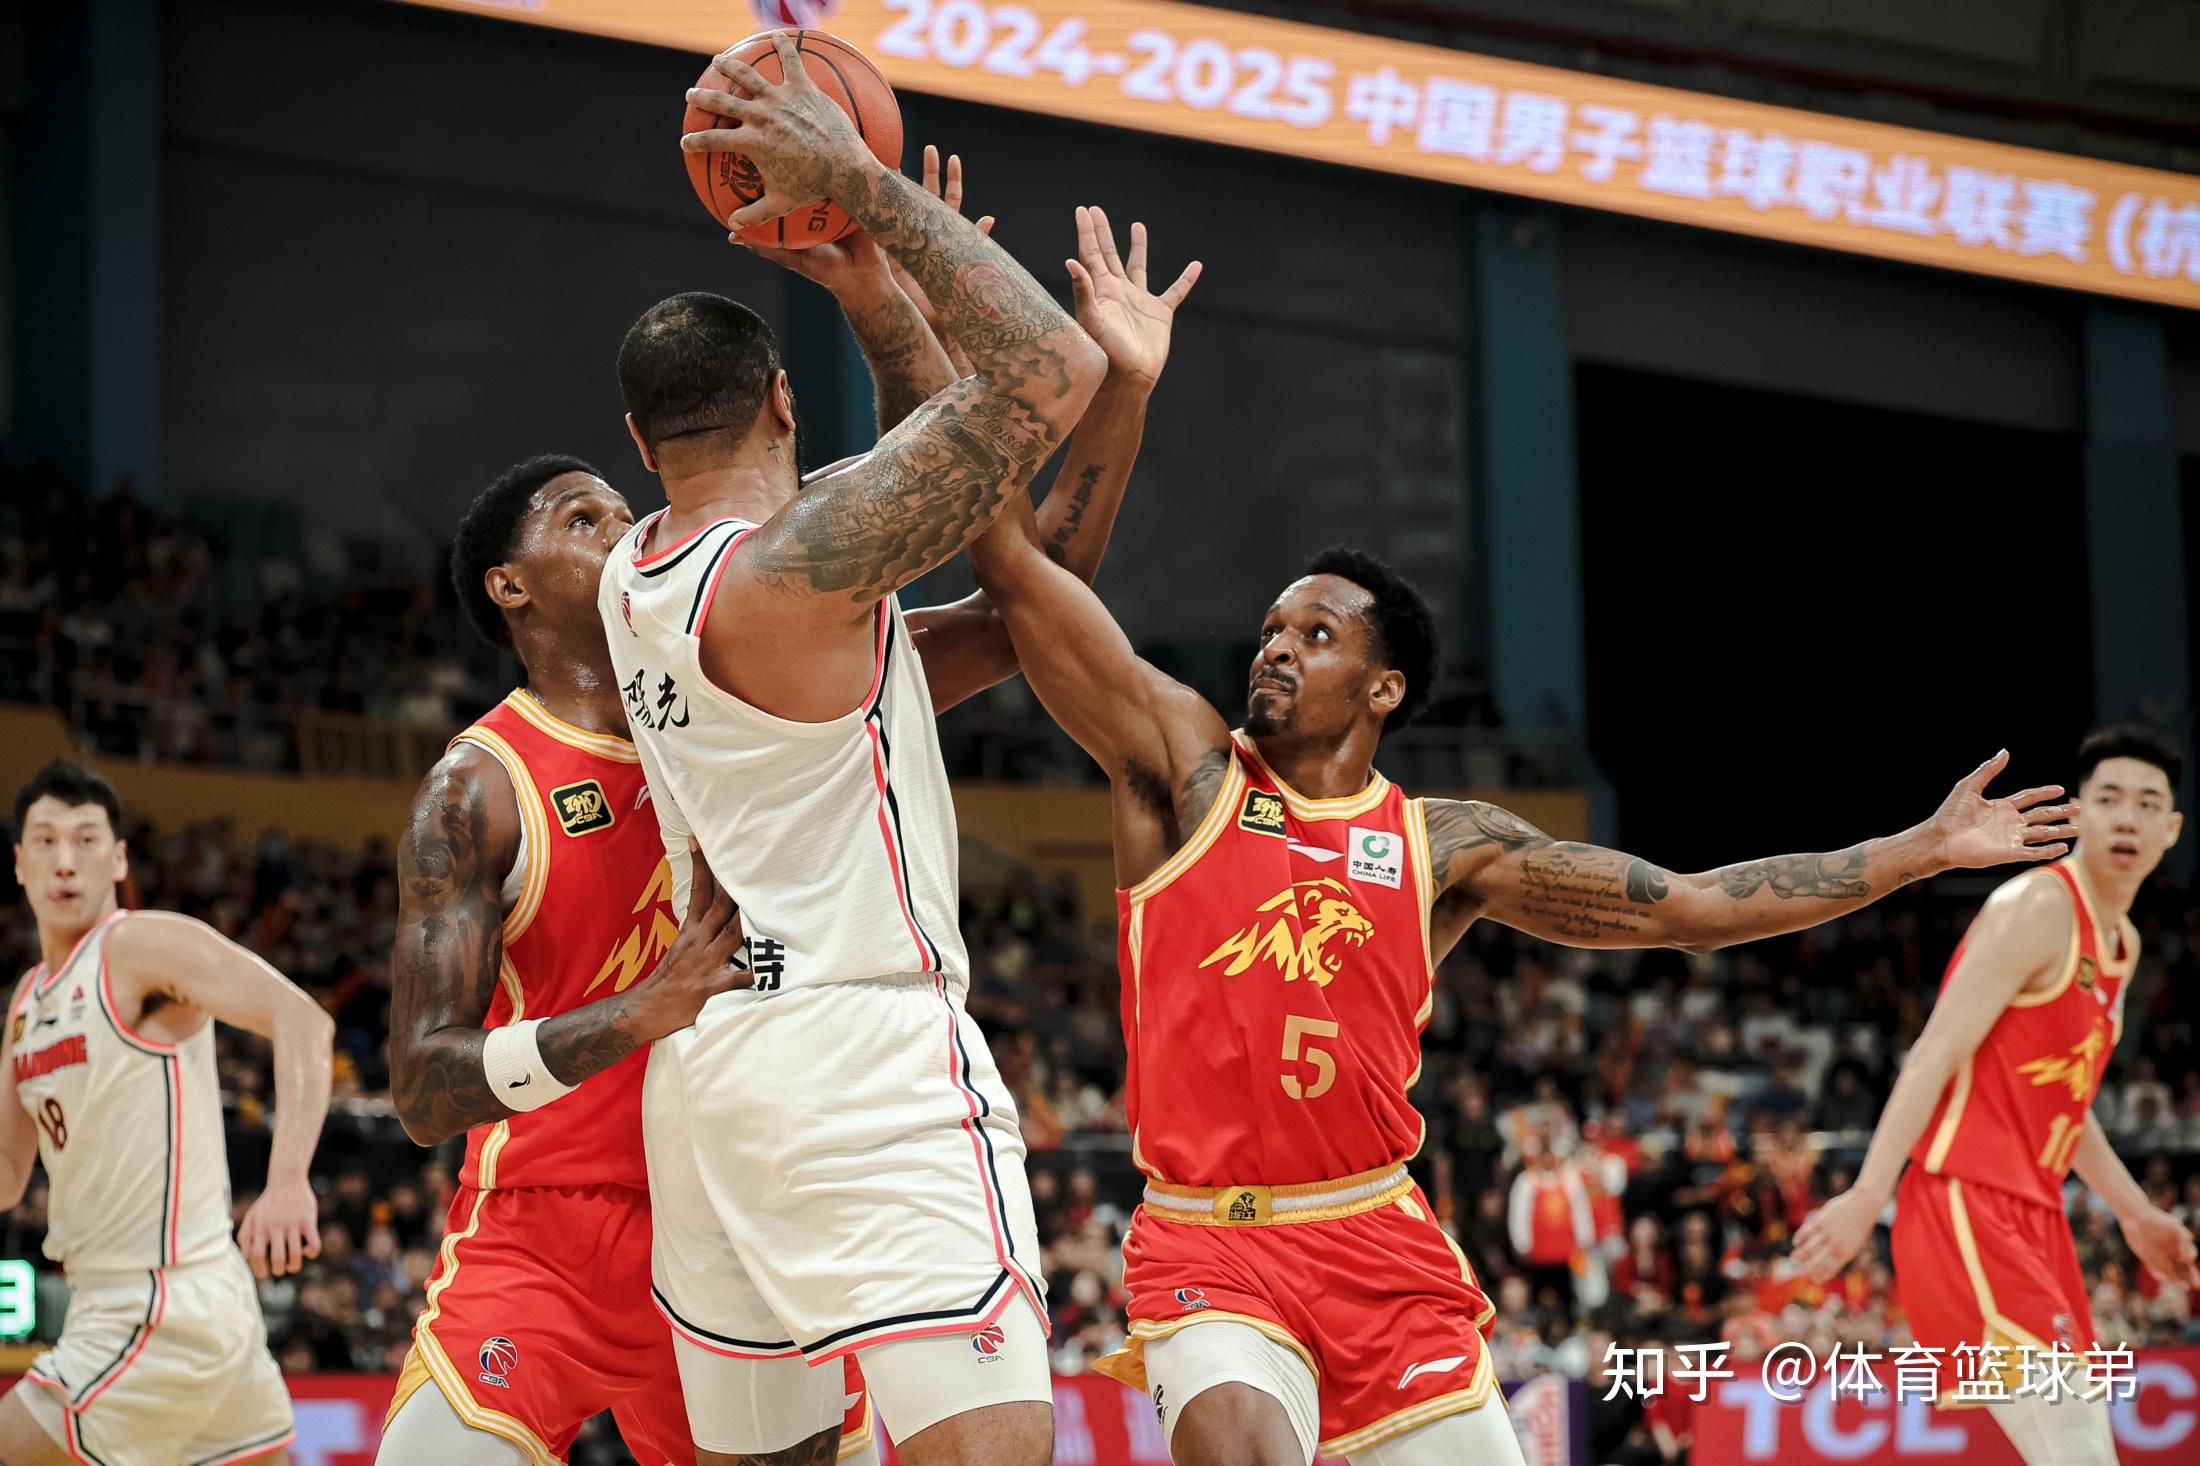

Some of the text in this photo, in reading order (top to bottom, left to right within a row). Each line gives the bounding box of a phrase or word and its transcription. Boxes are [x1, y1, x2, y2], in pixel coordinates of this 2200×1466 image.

[875, 0, 1336, 128] 2024-2025
[1351, 869, 1396, 882] CHINA LIFE
[1352, 860, 1397, 876] 中国人寿
[1280, 1014, 1339, 1100] 5
[479, 1372, 510, 1389] CBA
[1719, 1374, 1967, 1461] TCL
